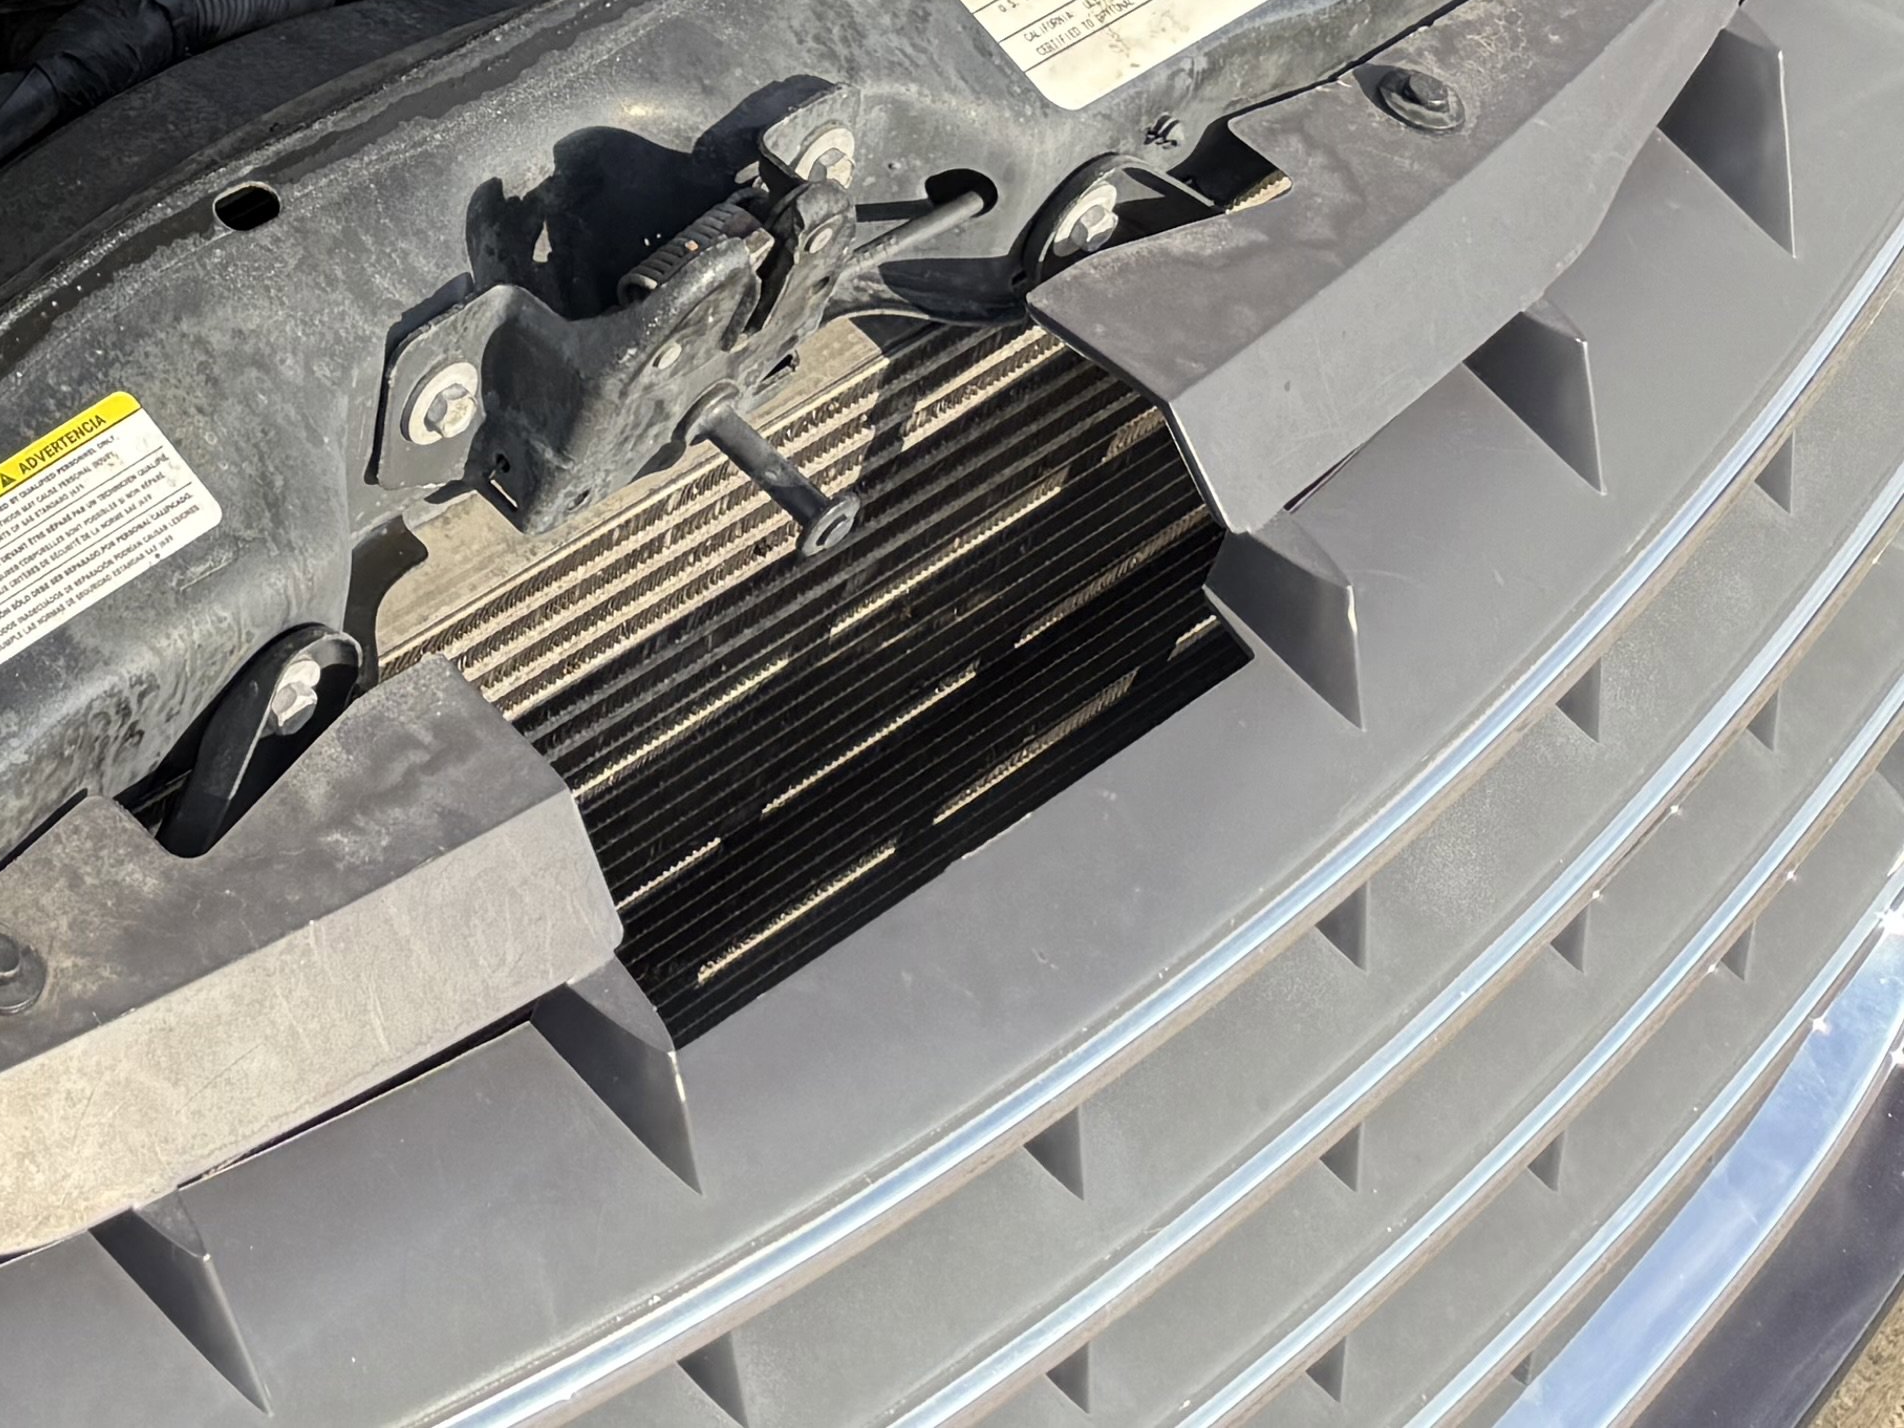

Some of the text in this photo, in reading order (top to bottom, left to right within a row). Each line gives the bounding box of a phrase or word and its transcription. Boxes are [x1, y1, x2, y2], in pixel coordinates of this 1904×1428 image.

[1034, 25, 1083, 57] CERTIFIED
[1080, 17, 1096, 30] TO
[16, 412, 106, 475] ADVERTENCIA
